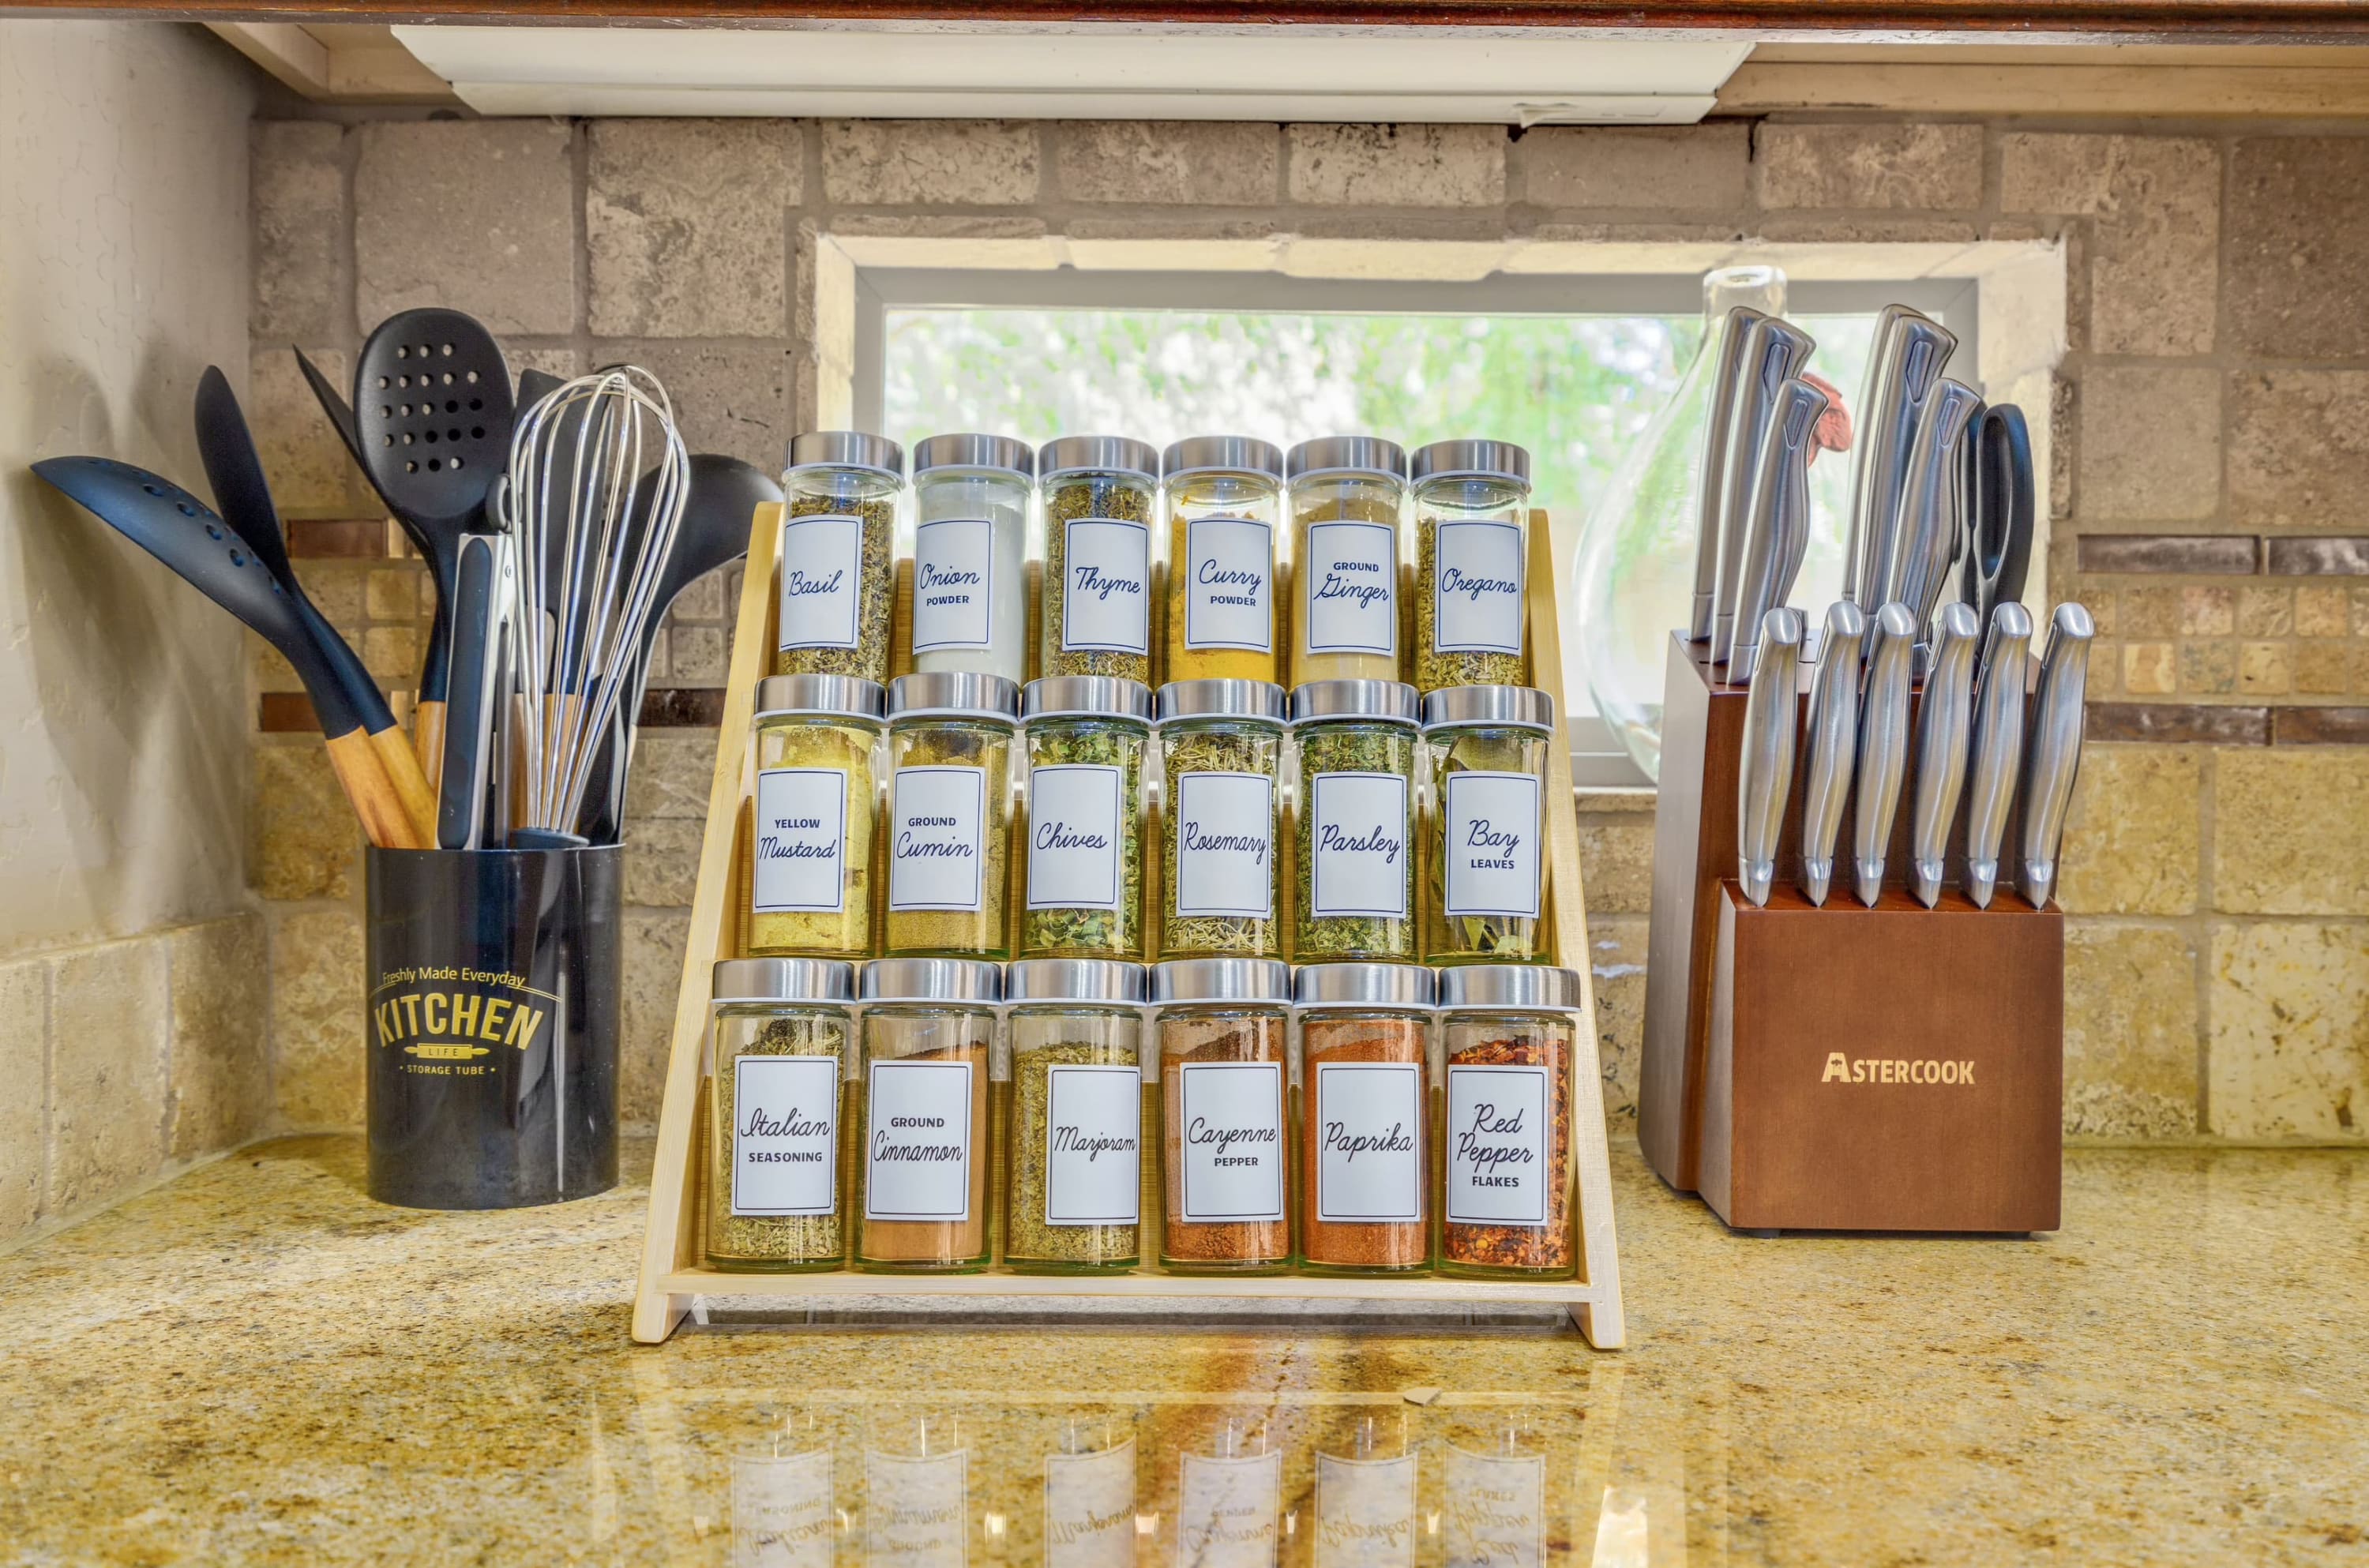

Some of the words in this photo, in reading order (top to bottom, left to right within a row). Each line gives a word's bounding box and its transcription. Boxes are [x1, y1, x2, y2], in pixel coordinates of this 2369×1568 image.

[919, 562, 981, 591] Onion
[1198, 558, 1263, 595] Curry
[1332, 561, 1380, 573] GROUND
[788, 568, 844, 598] Basil
[1075, 565, 1142, 601] Thyme
[1312, 572, 1390, 609] Ginger
[1441, 567, 1518, 602] Oregano
[925, 594, 971, 606] POWDER
[1210, 595, 1257, 607] POWDER
[774, 818, 821, 829] YELLOW
[907, 816, 957, 827] GROUND
[1035, 821, 1109, 850] Chives
[759, 835, 837, 861] Mustard
[896, 831, 974, 859] Cumin
[1183, 821, 1267, 865] Rosemary
[1319, 824, 1401, 865] Parsley
[1466, 819, 1520, 858] Bay
[1470, 858, 1515, 870] LEAVES
[382, 967, 416, 985] Freshly
[419, 966, 458, 981] Made
[461, 967, 526, 988] Everyday
[374, 992, 544, 1051] KITCHEN
[428, 1048, 460, 1057] LIFE
[407, 1064, 451, 1075] STORAGE
[456, 1065, 486, 1075] TUBE
[1820, 1052, 1976, 1085] ASTERCOOK
[740, 1107, 832, 1138] Italian
[890, 1116, 945, 1129] GROUND
[1472, 1103, 1525, 1135] Red
[873, 1129, 963, 1163] Cinnamon
[1053, 1126, 1136, 1162] Marjoram
[1188, 1116, 1277, 1154] Cayenne
[1323, 1122, 1414, 1163] Paprika
[748, 1151, 824, 1163] SEASONING
[1214, 1156, 1259, 1167] PEPPER
[1456, 1131, 1534, 1174] Pepper
[1471, 1176, 1520, 1188] FLAKES
